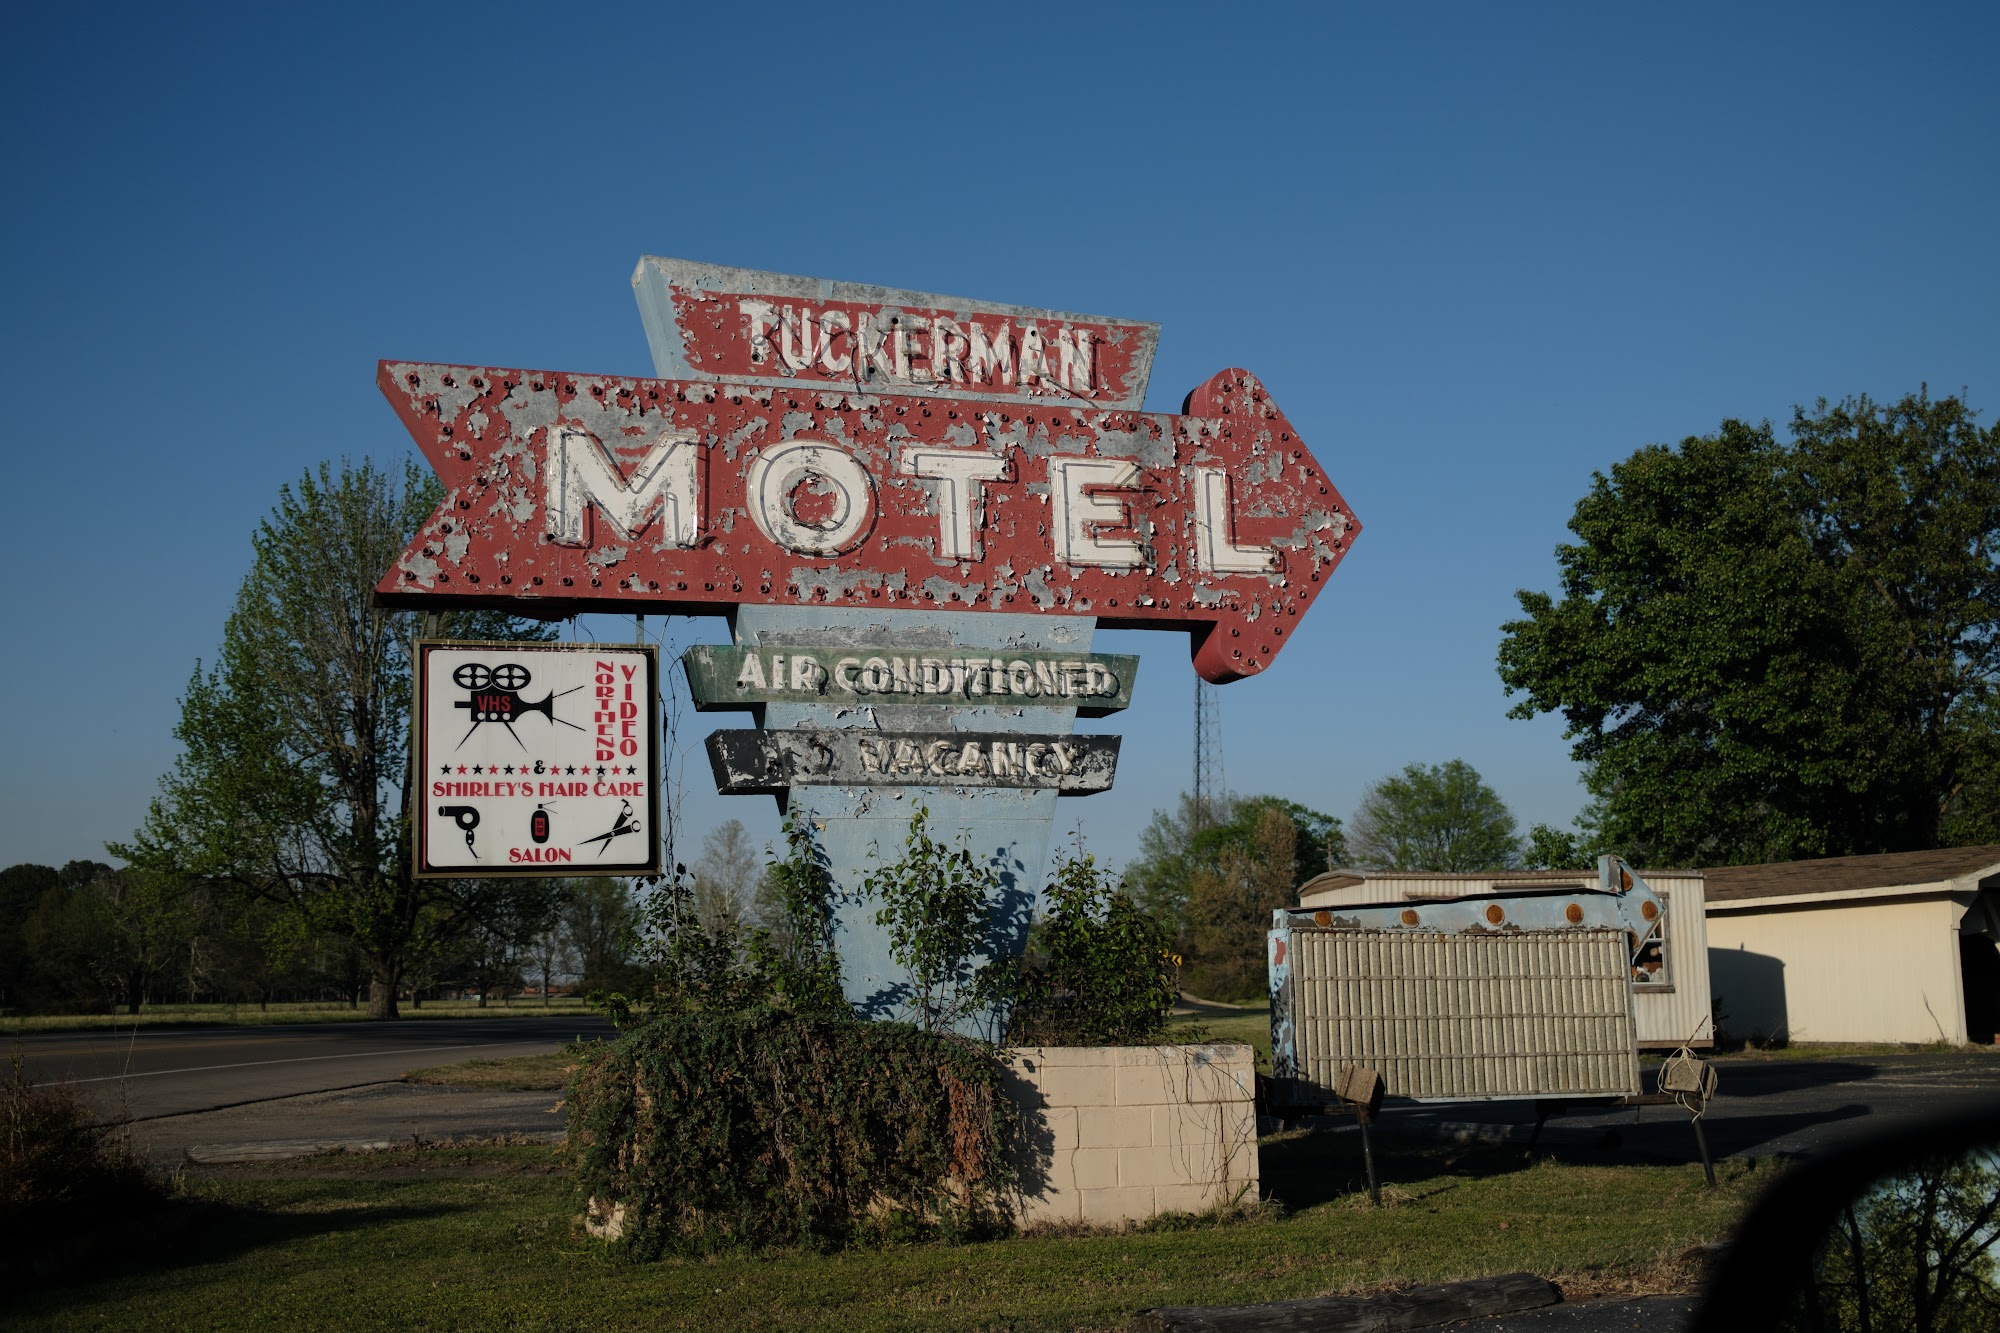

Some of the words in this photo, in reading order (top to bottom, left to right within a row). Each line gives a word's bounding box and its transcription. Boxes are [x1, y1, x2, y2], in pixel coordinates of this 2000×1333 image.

[739, 301, 1096, 392] TUCKERMAN
[545, 425, 1280, 574] MOTEL
[737, 653, 822, 692] AIR
[834, 656, 1113, 696] CONDITIONED
[477, 695, 511, 712] VHS
[619, 664, 638, 757] VIDEO
[533, 760, 546, 775] &
[860, 738, 1079, 776] VACANCY
[432, 781, 534, 797] SHIRLEY'S
[539, 781, 588, 797] HAIR
[593, 781, 644, 797] CARE
[509, 847, 572, 863] SALON
